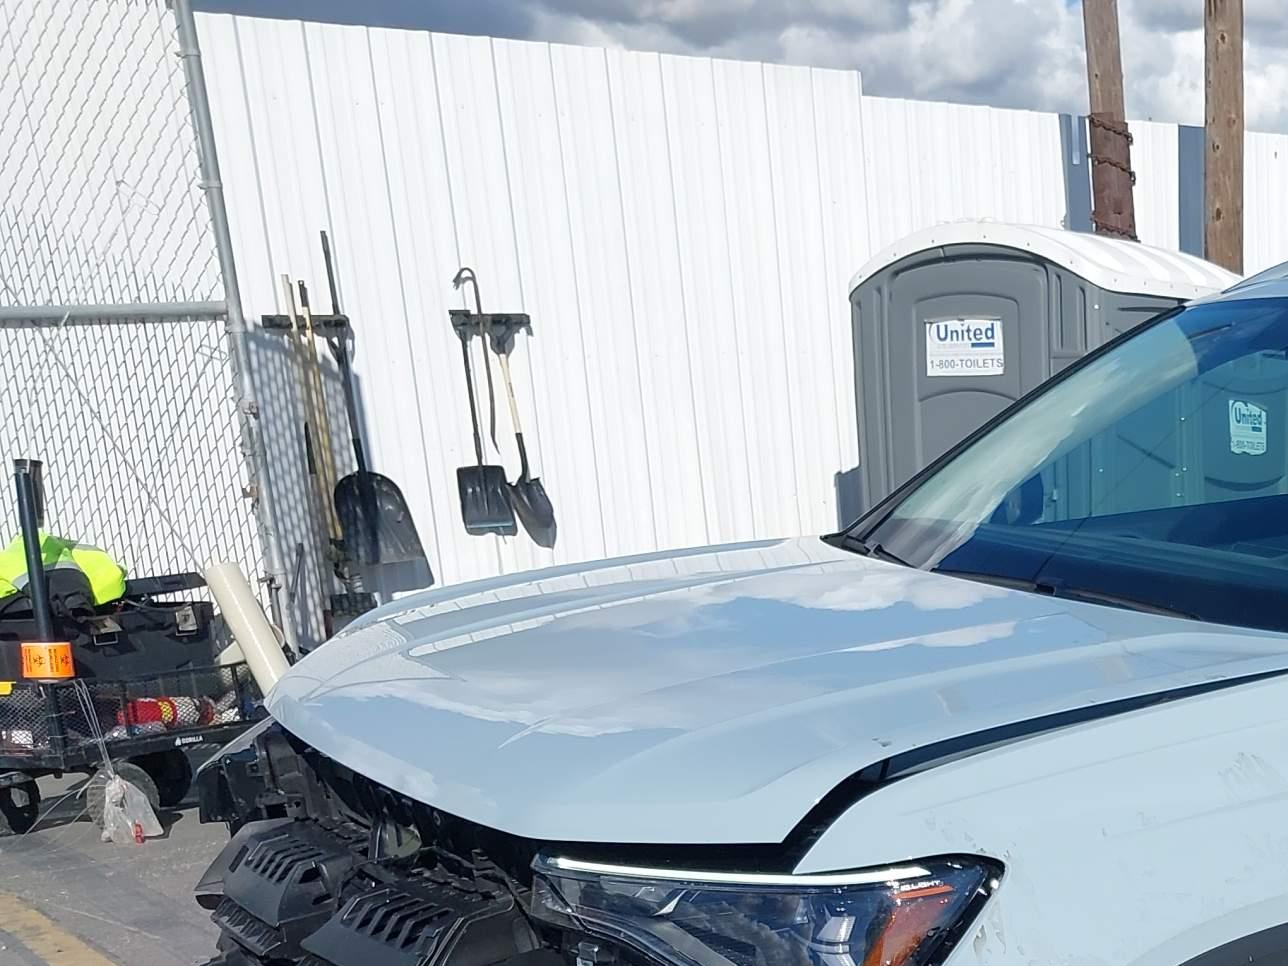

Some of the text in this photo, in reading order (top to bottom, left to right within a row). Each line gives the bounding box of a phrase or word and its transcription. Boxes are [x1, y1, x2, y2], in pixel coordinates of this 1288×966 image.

[935, 322, 995, 342] United
[929, 358, 1005, 370] 1-800-TOILETS
[1234, 406, 1263, 426] United
